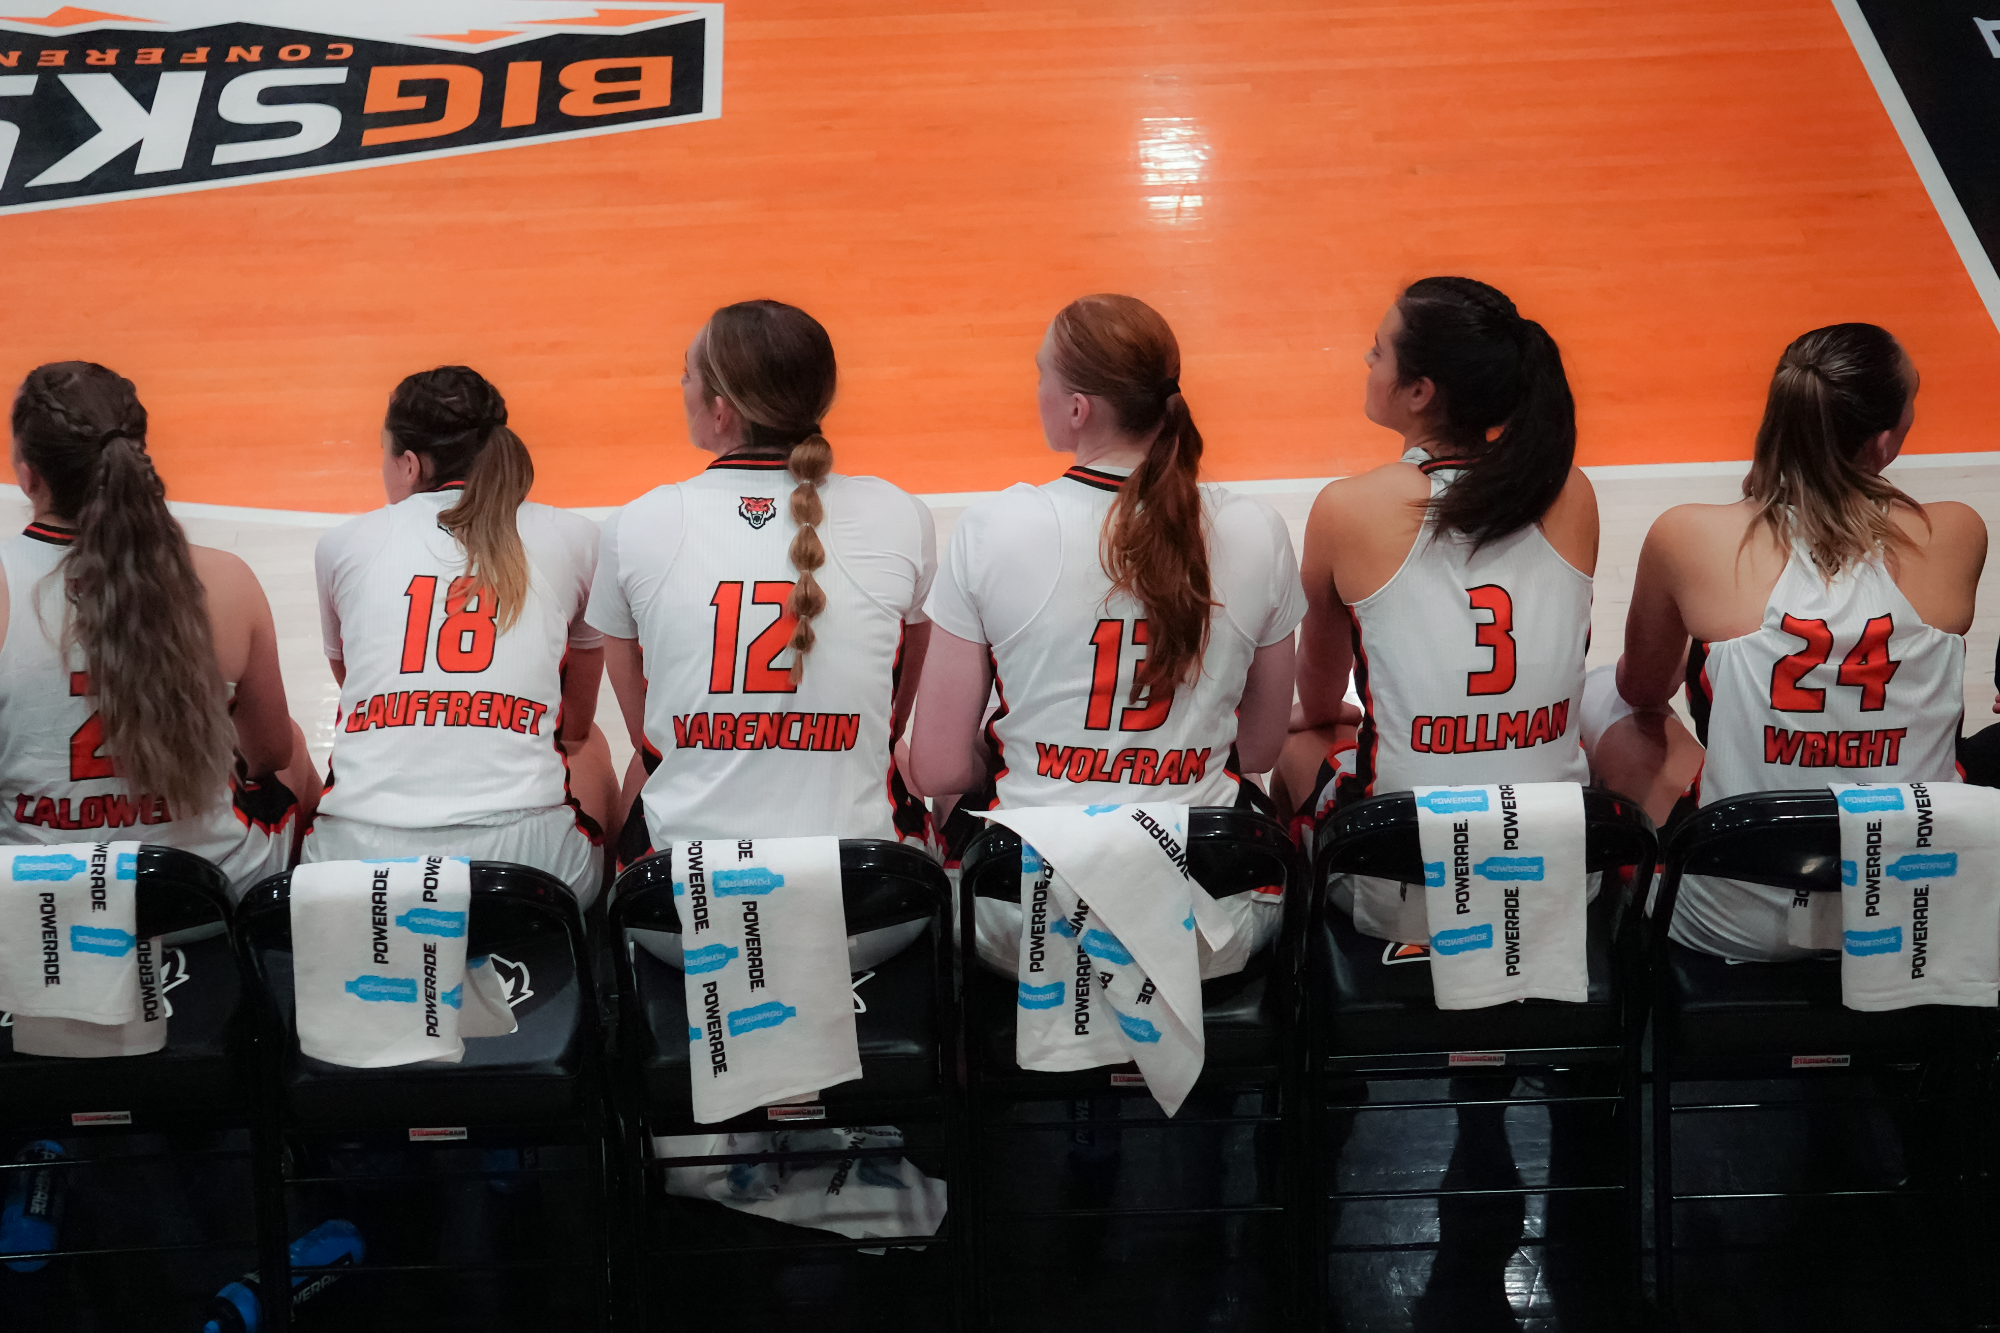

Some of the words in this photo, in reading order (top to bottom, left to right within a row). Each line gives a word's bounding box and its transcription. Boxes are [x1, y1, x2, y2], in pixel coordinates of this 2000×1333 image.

[361, 56, 673, 146] BIG
[400, 574, 500, 674] 18
[709, 581, 800, 694] 12
[1465, 584, 1517, 696] 3
[1770, 613, 1902, 713] 24
[345, 691, 547, 735] GAUFFRENET
[1411, 698, 1570, 754] COLLMAN
[1764, 725, 1907, 768] WRIGHT
[1035, 742, 1211, 786] WOLFRAM
